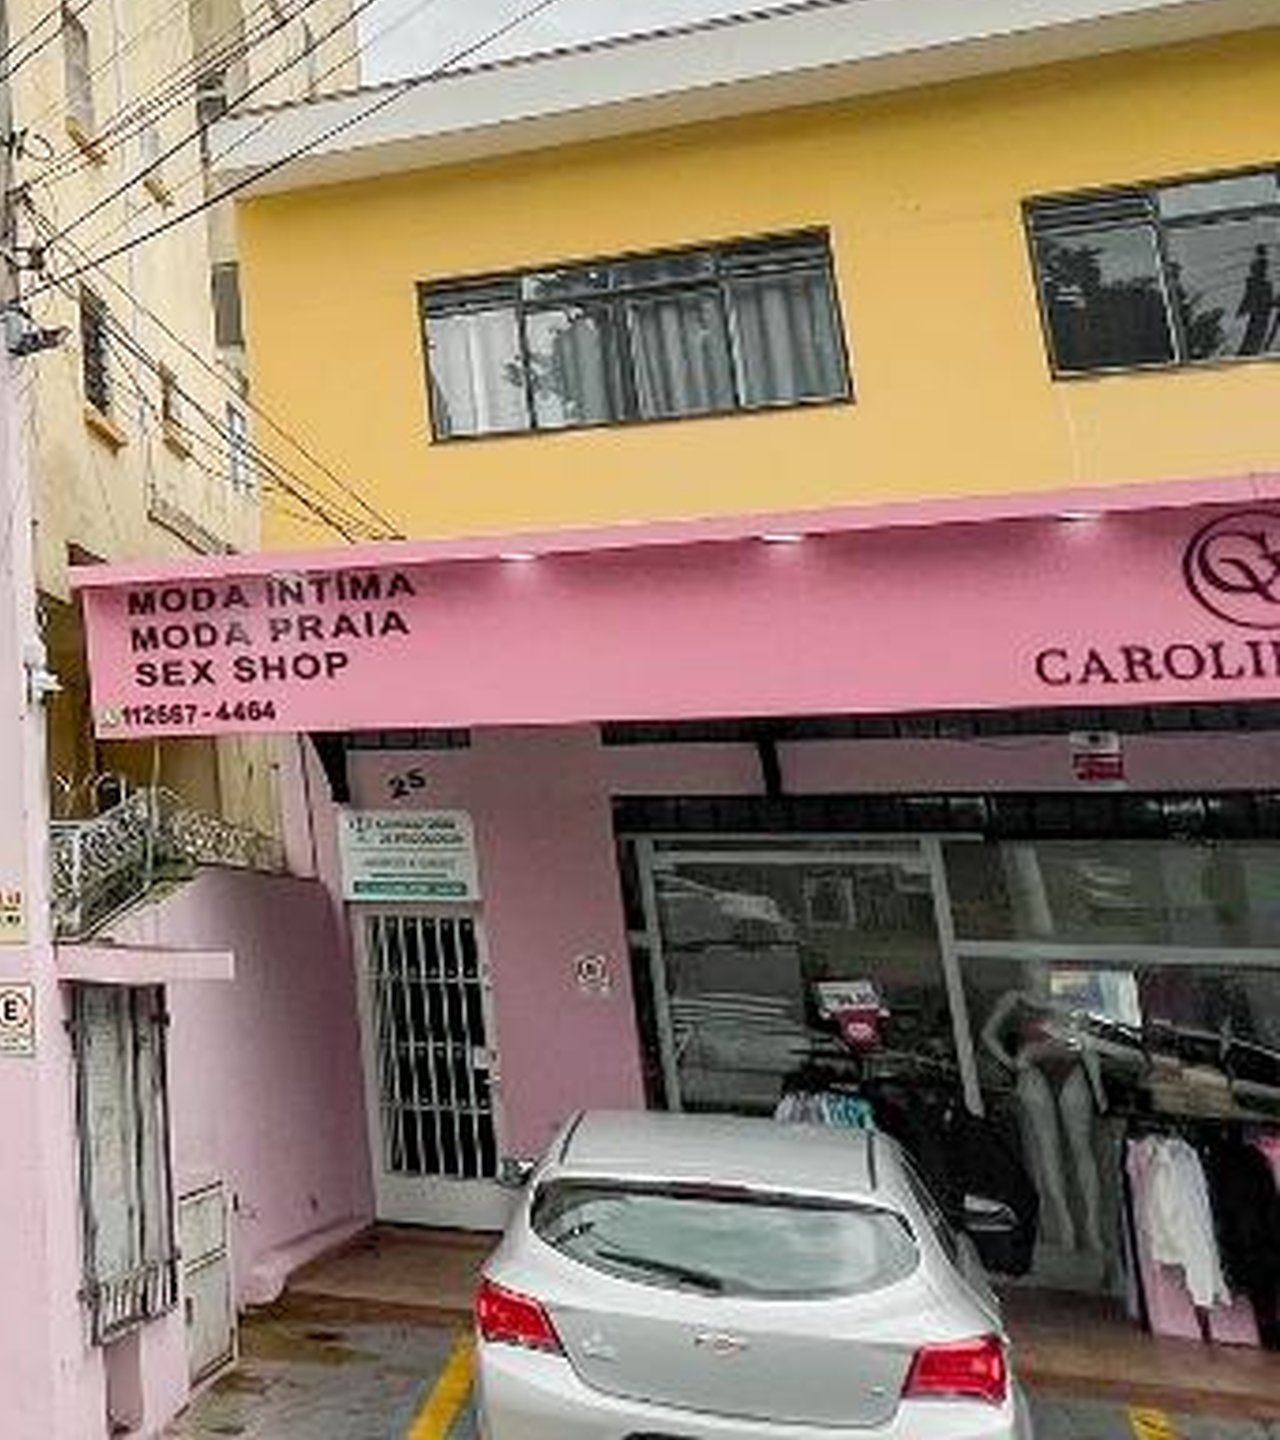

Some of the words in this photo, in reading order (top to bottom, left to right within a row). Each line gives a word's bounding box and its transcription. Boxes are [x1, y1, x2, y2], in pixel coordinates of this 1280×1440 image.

[127, 584, 250, 615] MODA
[132, 621, 252, 652] MODA
[269, 610, 410, 642] PRAIA
[135, 659, 215, 687] SEX
[233, 651, 349, 683] SHOP
[1035, 640, 1280, 686] CAROLI
